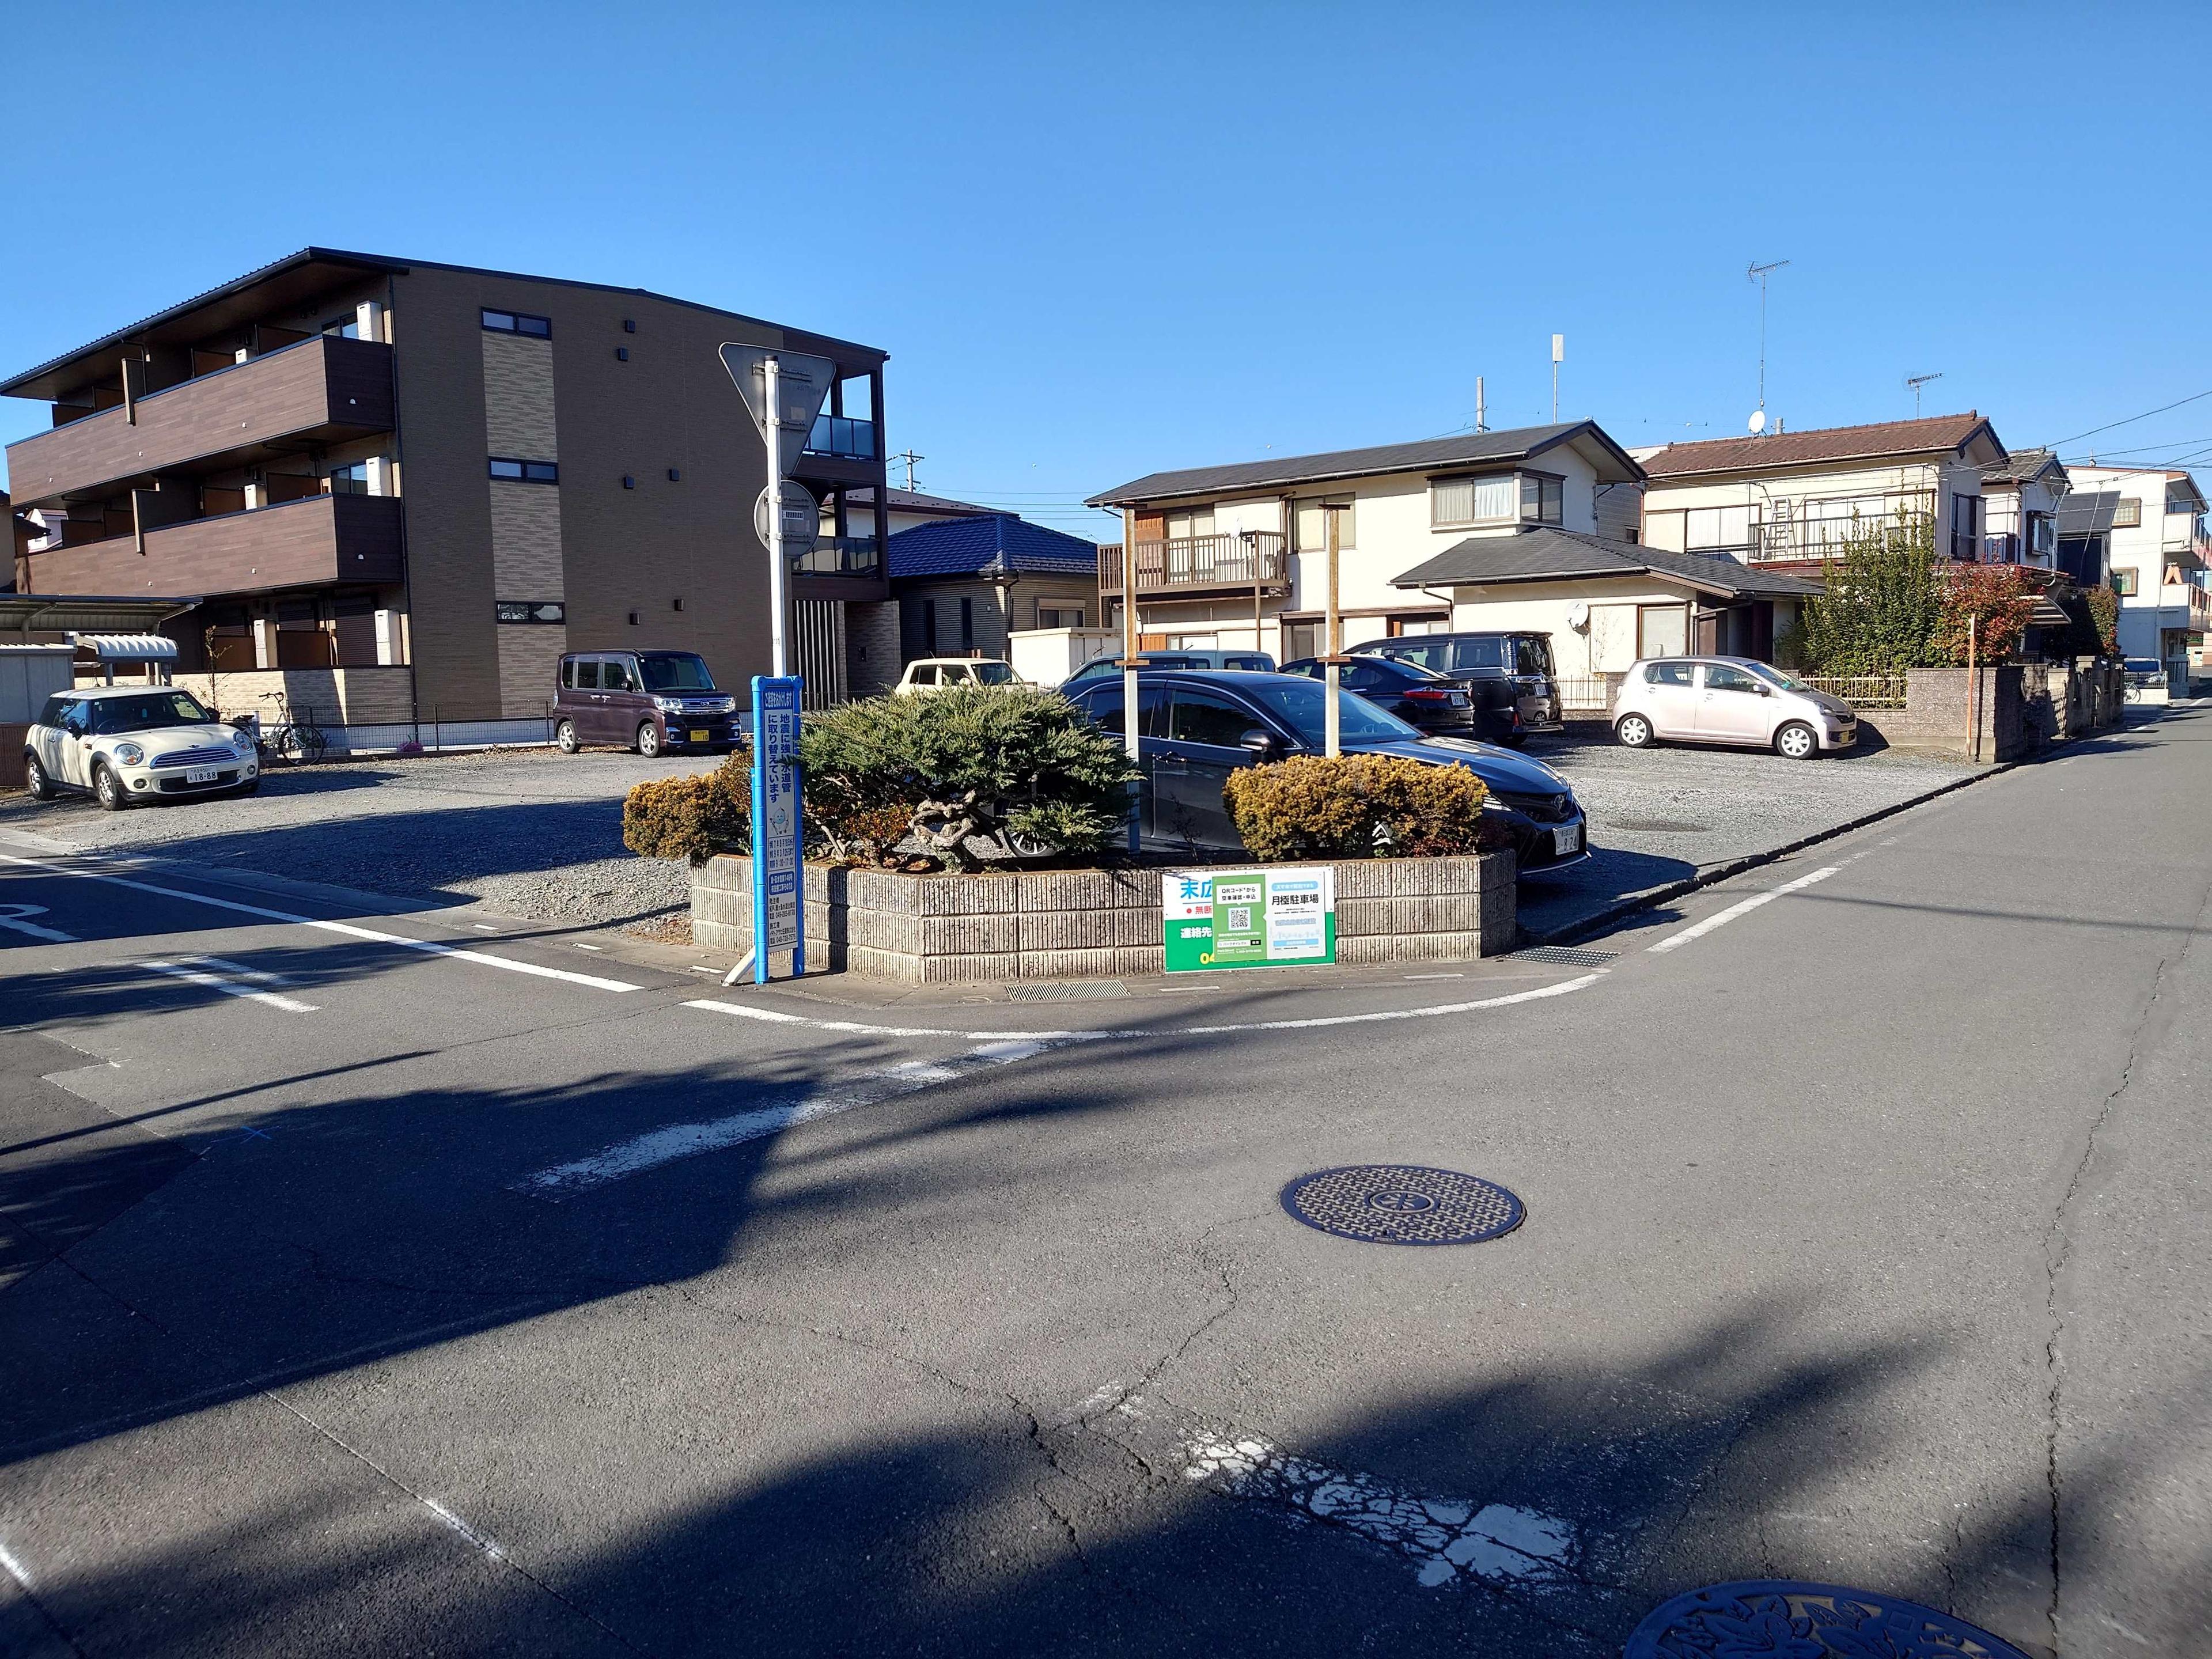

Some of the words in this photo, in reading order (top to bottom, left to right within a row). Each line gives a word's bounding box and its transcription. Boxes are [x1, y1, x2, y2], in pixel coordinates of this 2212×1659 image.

[768, 714, 779, 804] に取り替えています
[195, 771, 216, 781] 18-88
[1272, 894, 1319, 906] 月極駐車場
[1180, 926, 1213, 939] 連絡先
